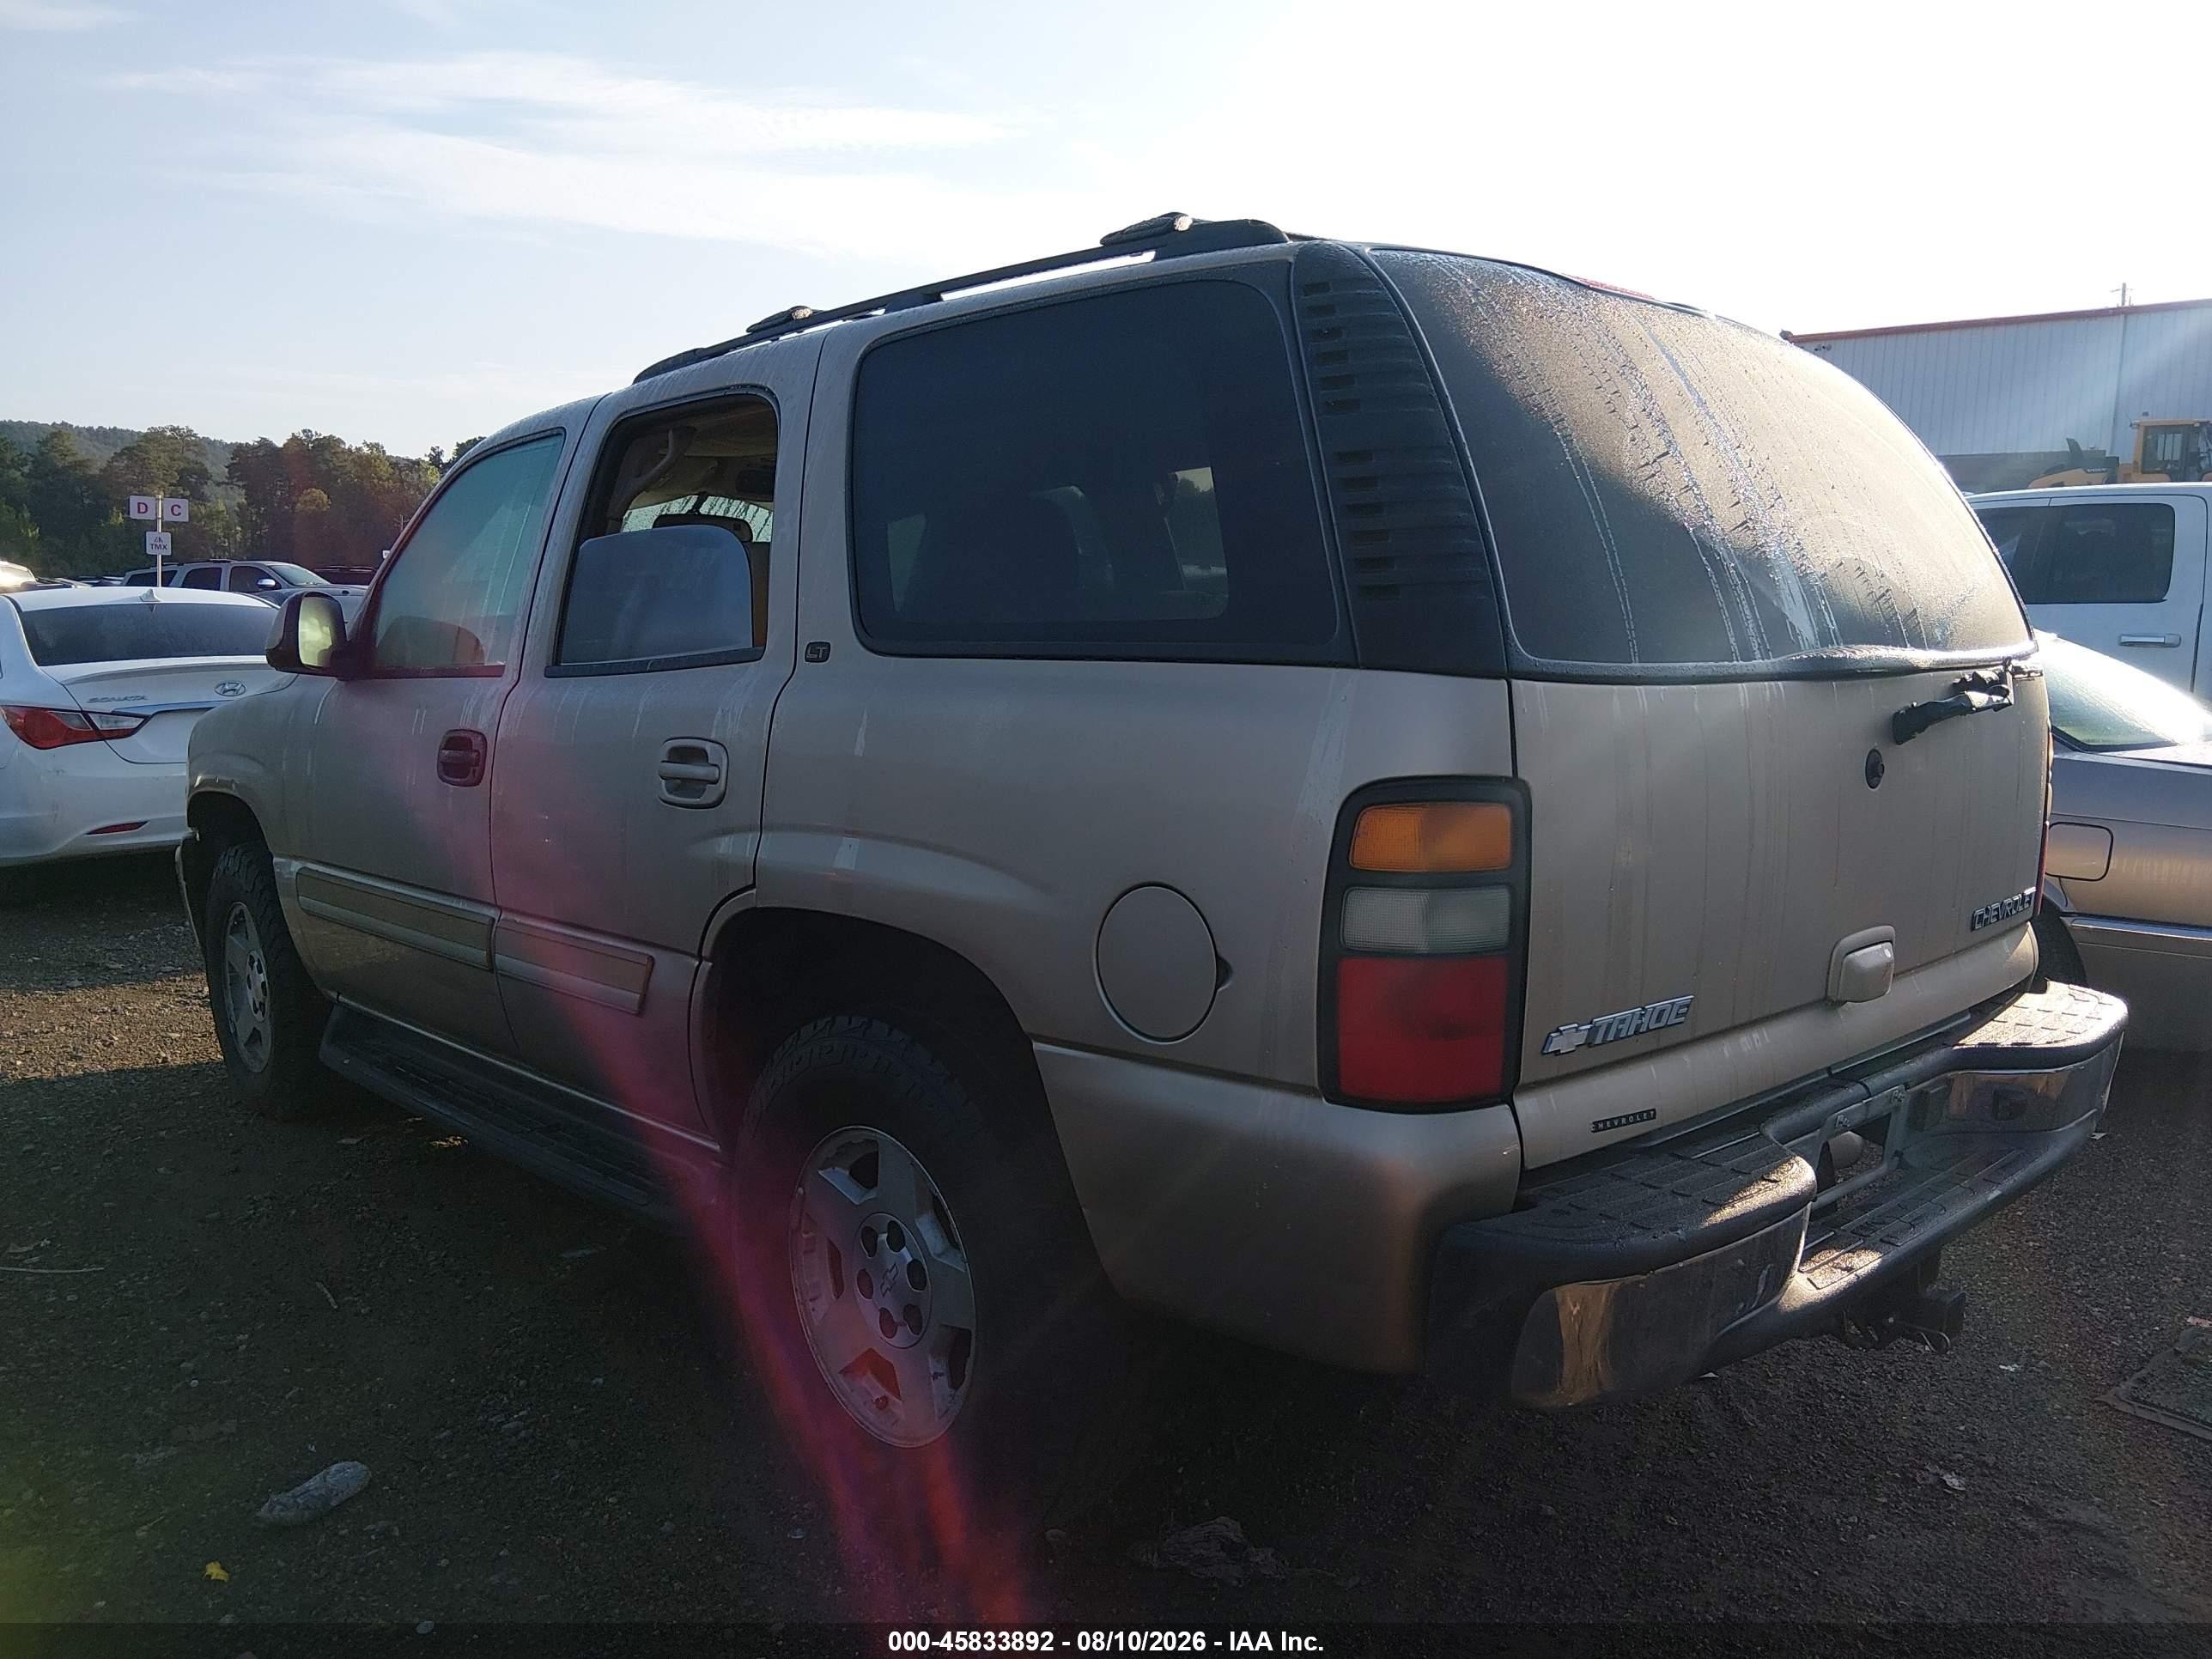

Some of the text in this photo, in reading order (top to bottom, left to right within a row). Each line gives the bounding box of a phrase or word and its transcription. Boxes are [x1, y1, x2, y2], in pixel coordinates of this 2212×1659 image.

[137, 502, 148, 514] D
[171, 504, 181, 516] C
[806, 646, 828, 659] LT
[1589, 995, 1694, 1046] TAHOE
